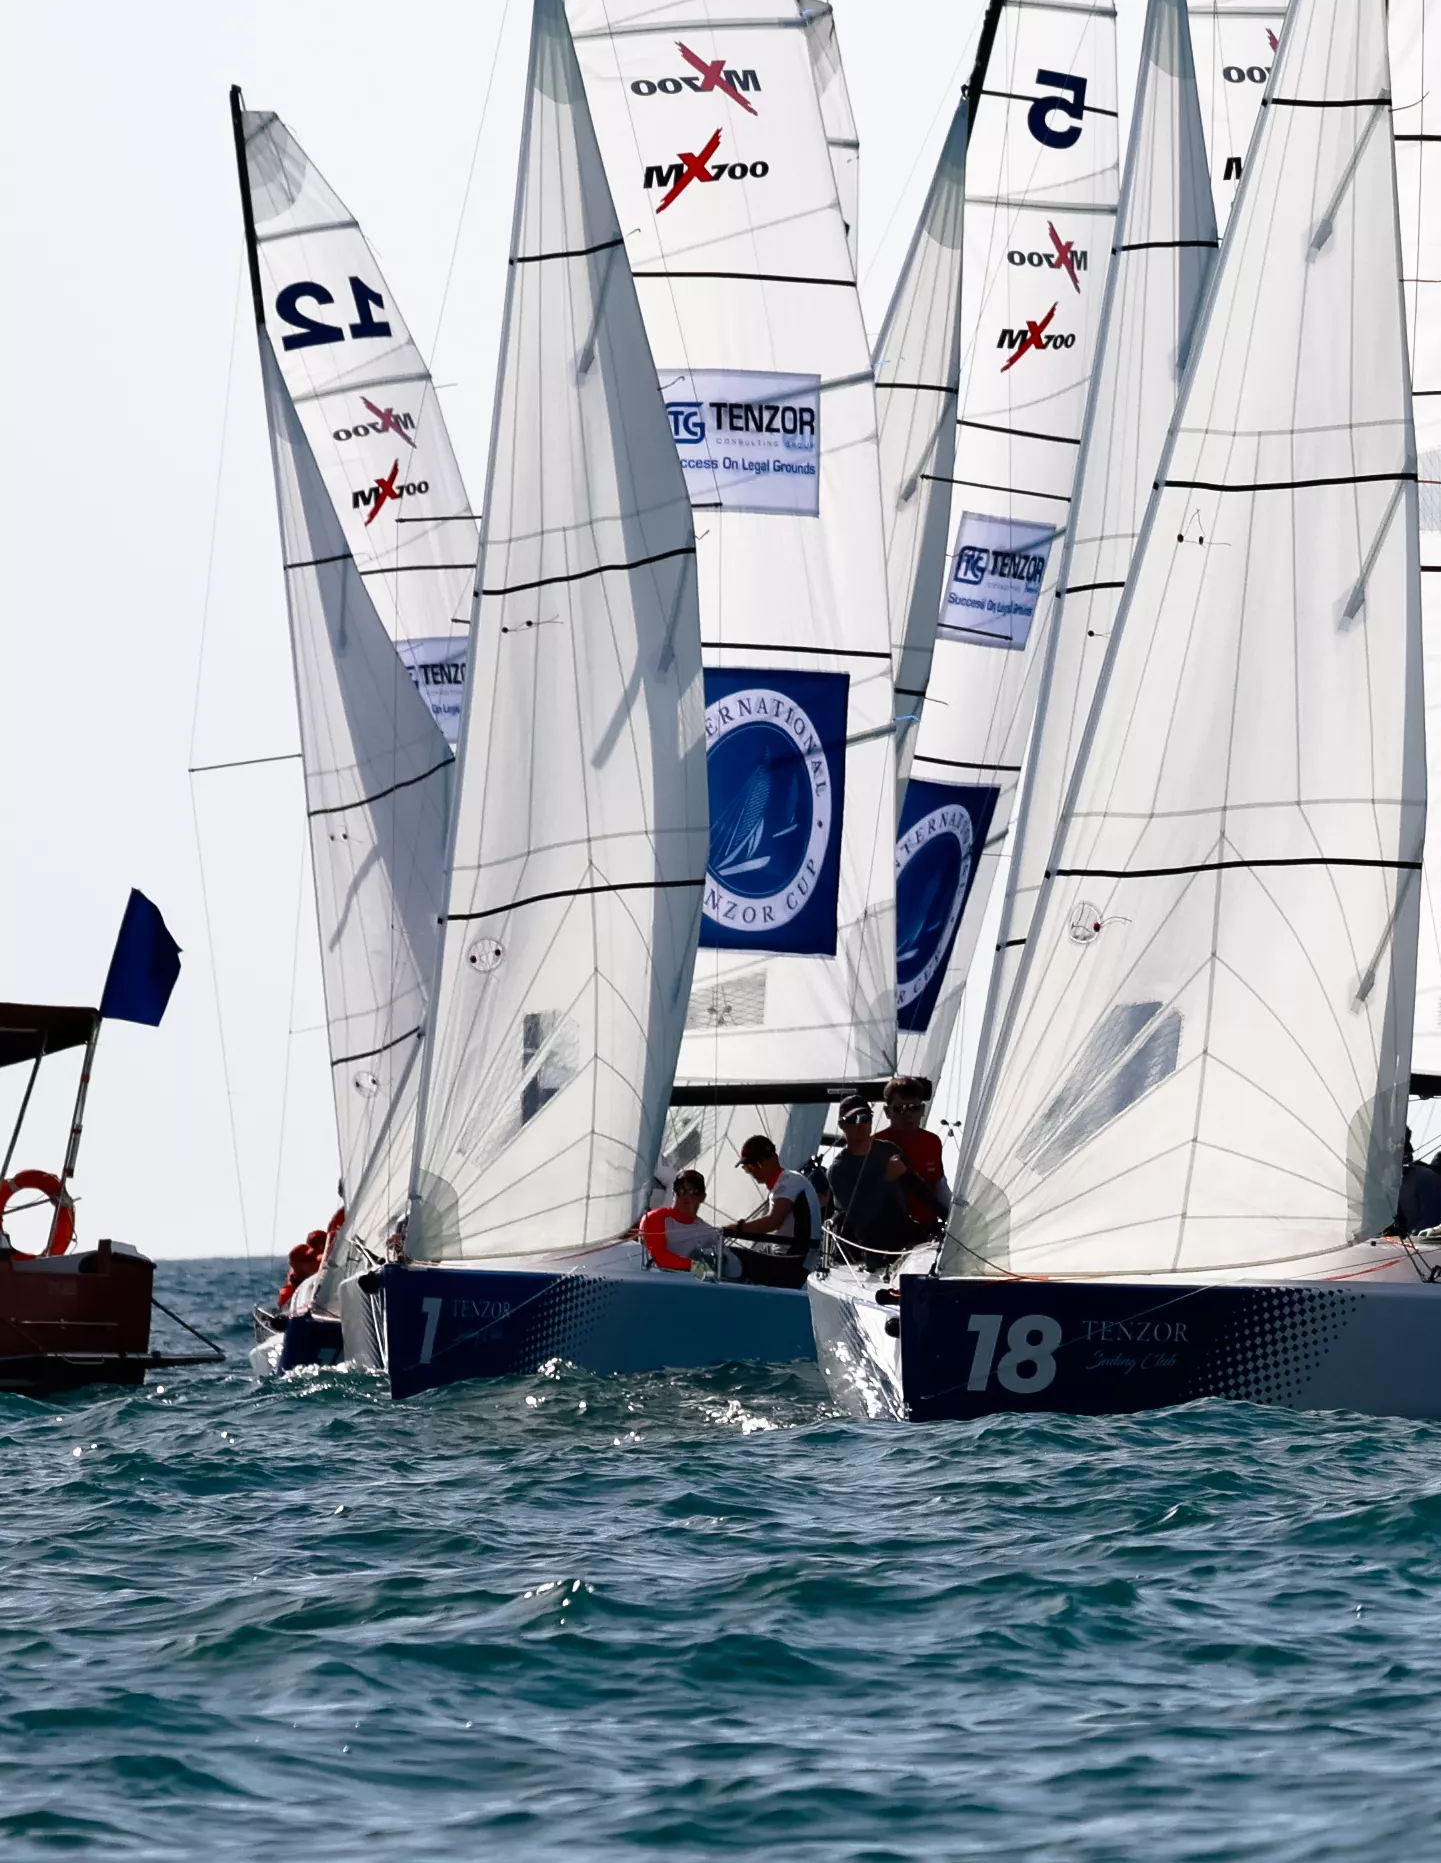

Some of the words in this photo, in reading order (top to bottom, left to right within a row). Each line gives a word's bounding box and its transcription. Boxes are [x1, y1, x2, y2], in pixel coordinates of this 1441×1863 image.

[643, 127, 769, 215] MX700
[997, 301, 1075, 372] MX700
[709, 402, 815, 436] TENZOR
[352, 458, 430, 527] MX700
[680, 458, 718, 470] ccess
[722, 456, 738, 470] On
[742, 457, 770, 474] Legal
[773, 459, 815, 475] Grounds
[991, 550, 1045, 583] TENZOR
[948, 592, 986, 611] Success
[419, 663, 466, 685] TENZ
[705, 697, 828, 797] ERNATIONAL
[704, 887, 775, 924] NZOR
[786, 858, 816, 910] CUP
[420, 1297, 442, 1364] 1
[967, 1314, 1062, 1394] 18
[1082, 1320, 1189, 1343] TENZOR
